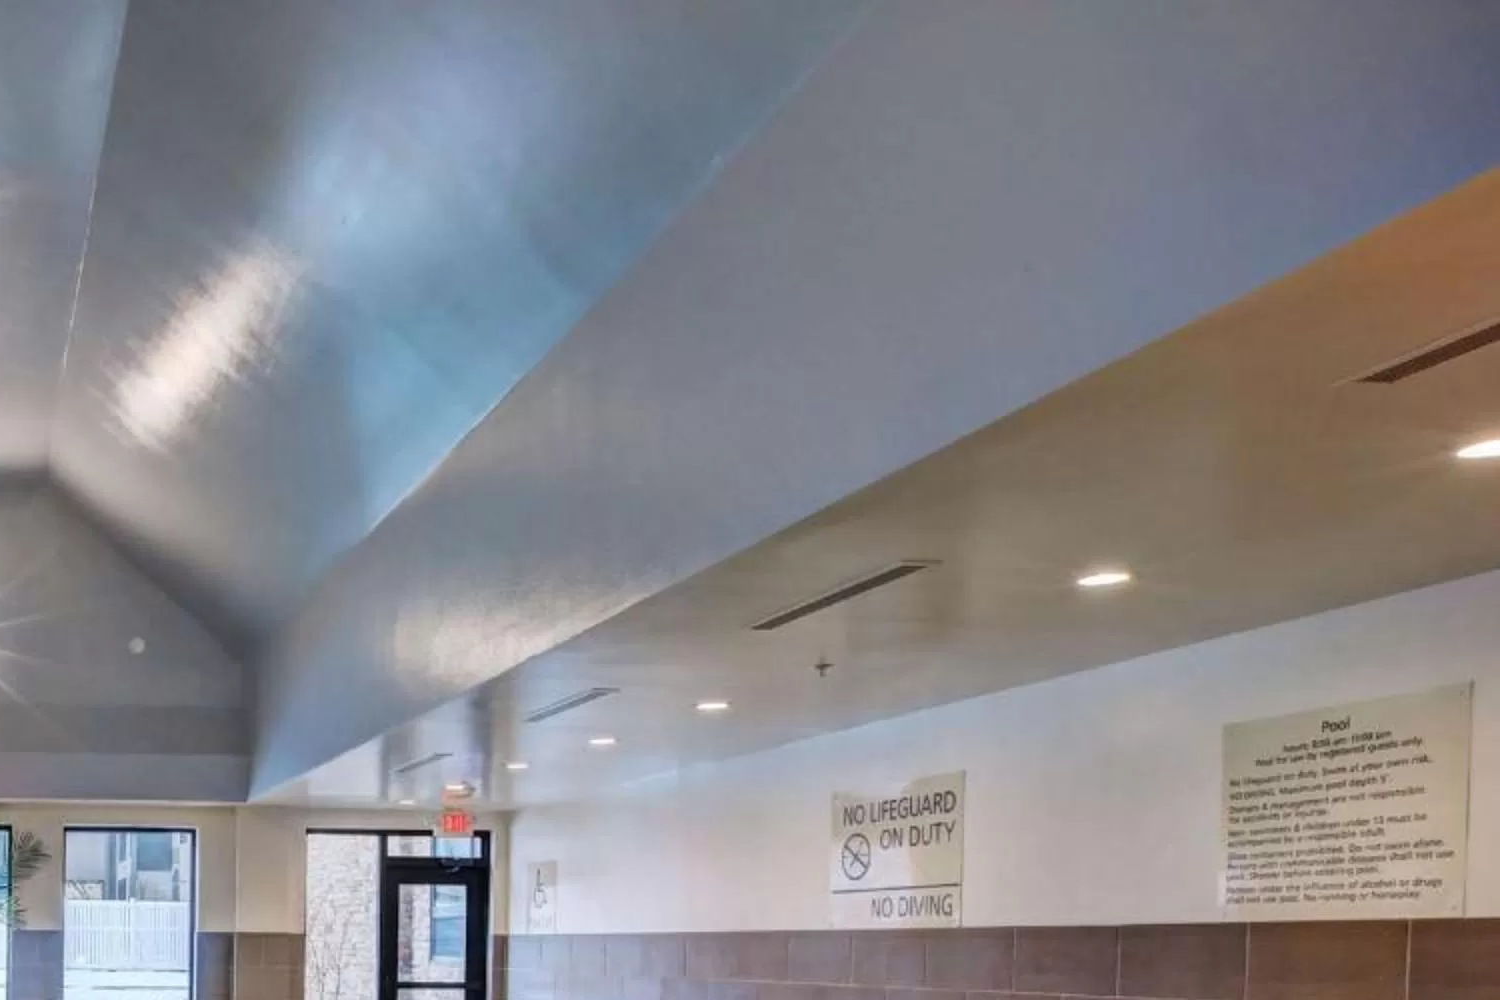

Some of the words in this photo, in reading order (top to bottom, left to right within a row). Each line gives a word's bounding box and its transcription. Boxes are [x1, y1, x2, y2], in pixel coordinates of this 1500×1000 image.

[1321, 715, 1350, 733] Pool
[843, 804, 865, 826] NO
[870, 790, 957, 823] LIFEGUARD
[880, 827, 903, 849] ON
[909, 820, 956, 847] DUTY
[871, 896, 893, 918] NO
[898, 894, 953, 917] DIVING
